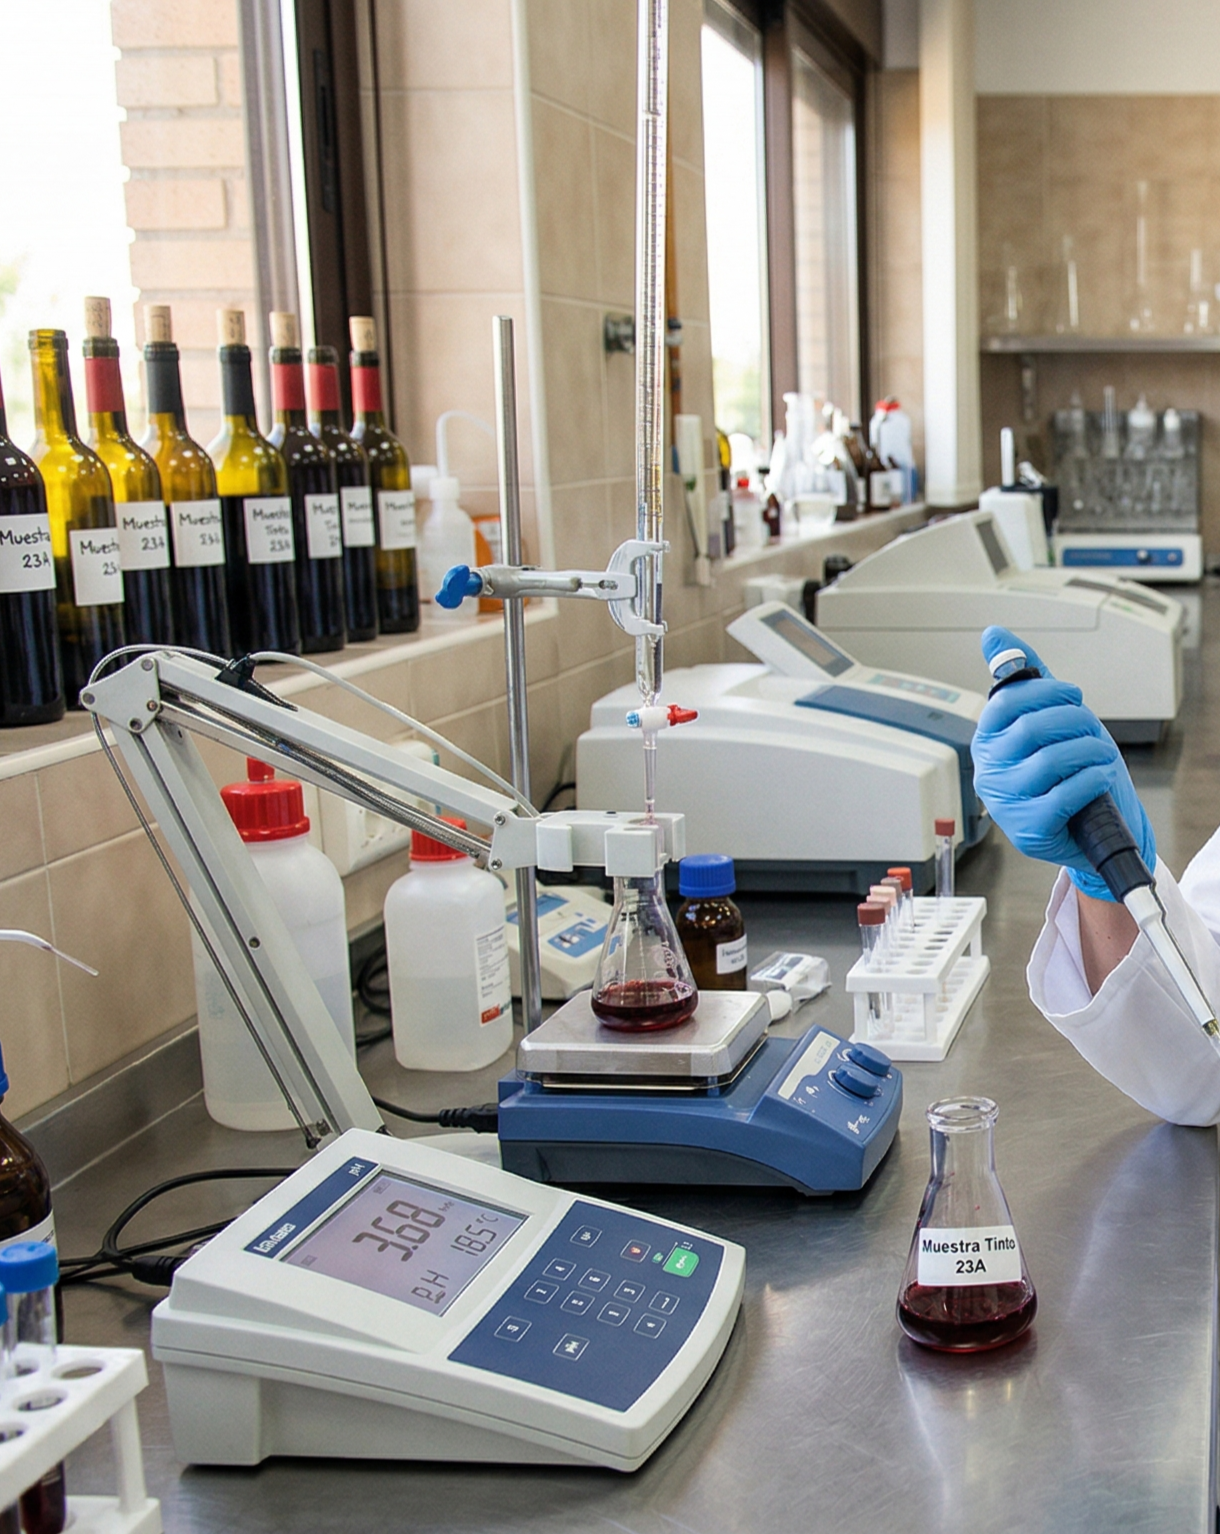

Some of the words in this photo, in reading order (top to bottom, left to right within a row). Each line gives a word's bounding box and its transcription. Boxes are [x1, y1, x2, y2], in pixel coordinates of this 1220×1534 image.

[22, 551, 50, 569] 23A
[351, 1200, 446, 1262] 3.68
[922, 1239, 980, 1253] Muestra
[984, 1237, 1016, 1251] Tinto
[956, 1258, 987, 1274] 23A
